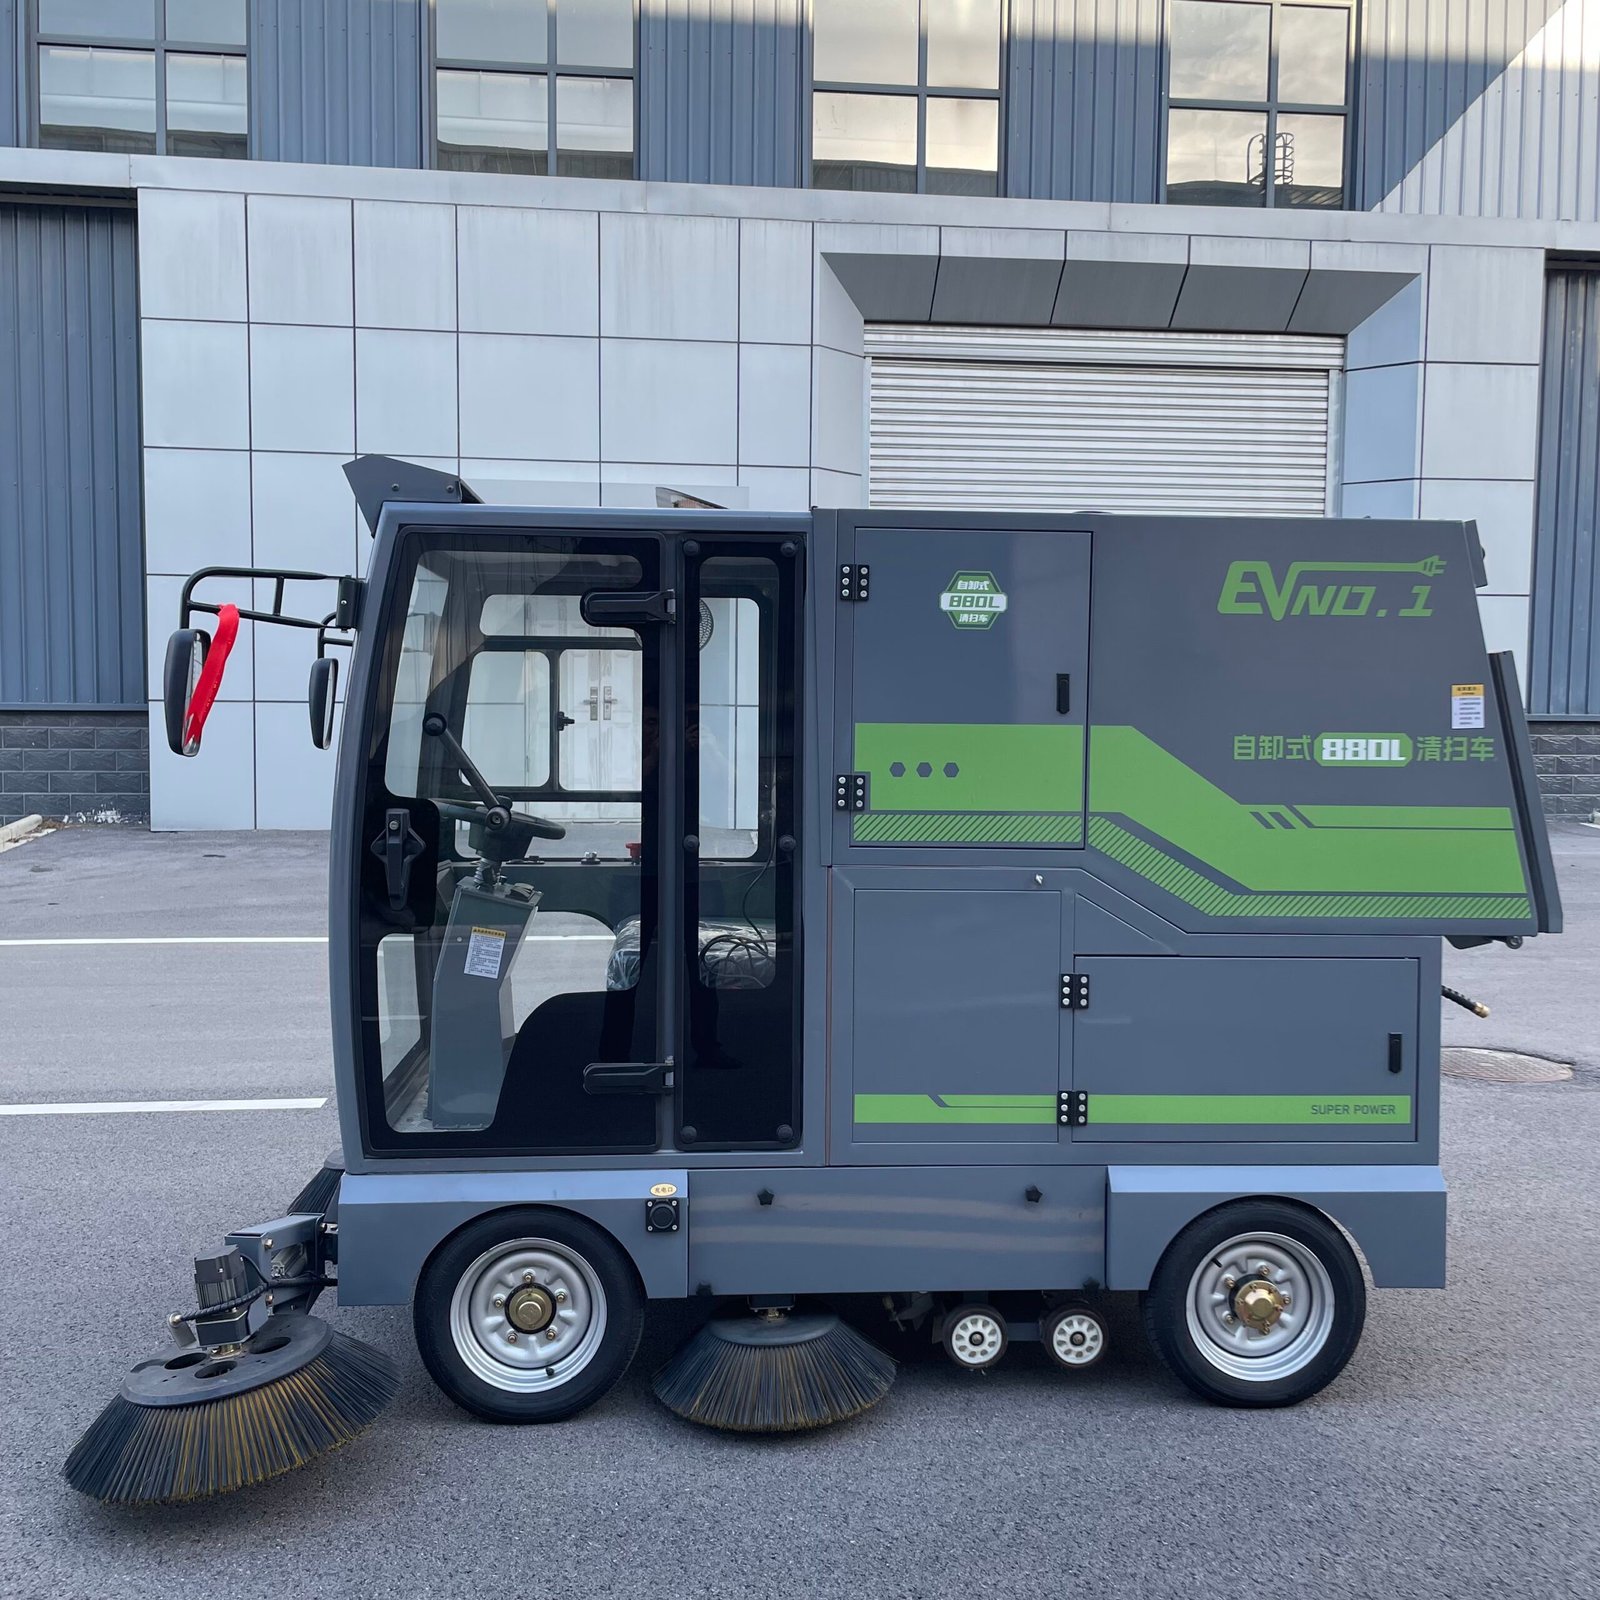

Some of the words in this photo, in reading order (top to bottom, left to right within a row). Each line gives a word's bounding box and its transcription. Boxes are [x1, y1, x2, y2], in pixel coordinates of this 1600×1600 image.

[957, 580, 990, 590] 自卸式
[949, 595, 1001, 608] 880L
[958, 613, 989, 623] 清扫车
[1233, 735, 1312, 761] 自卸式
[1322, 738, 1406, 761] 880L
[1416, 736, 1495, 762] 清扫车
[1311, 1104, 1350, 1115] SUPER
[1353, 1104, 1396, 1115] POWER
